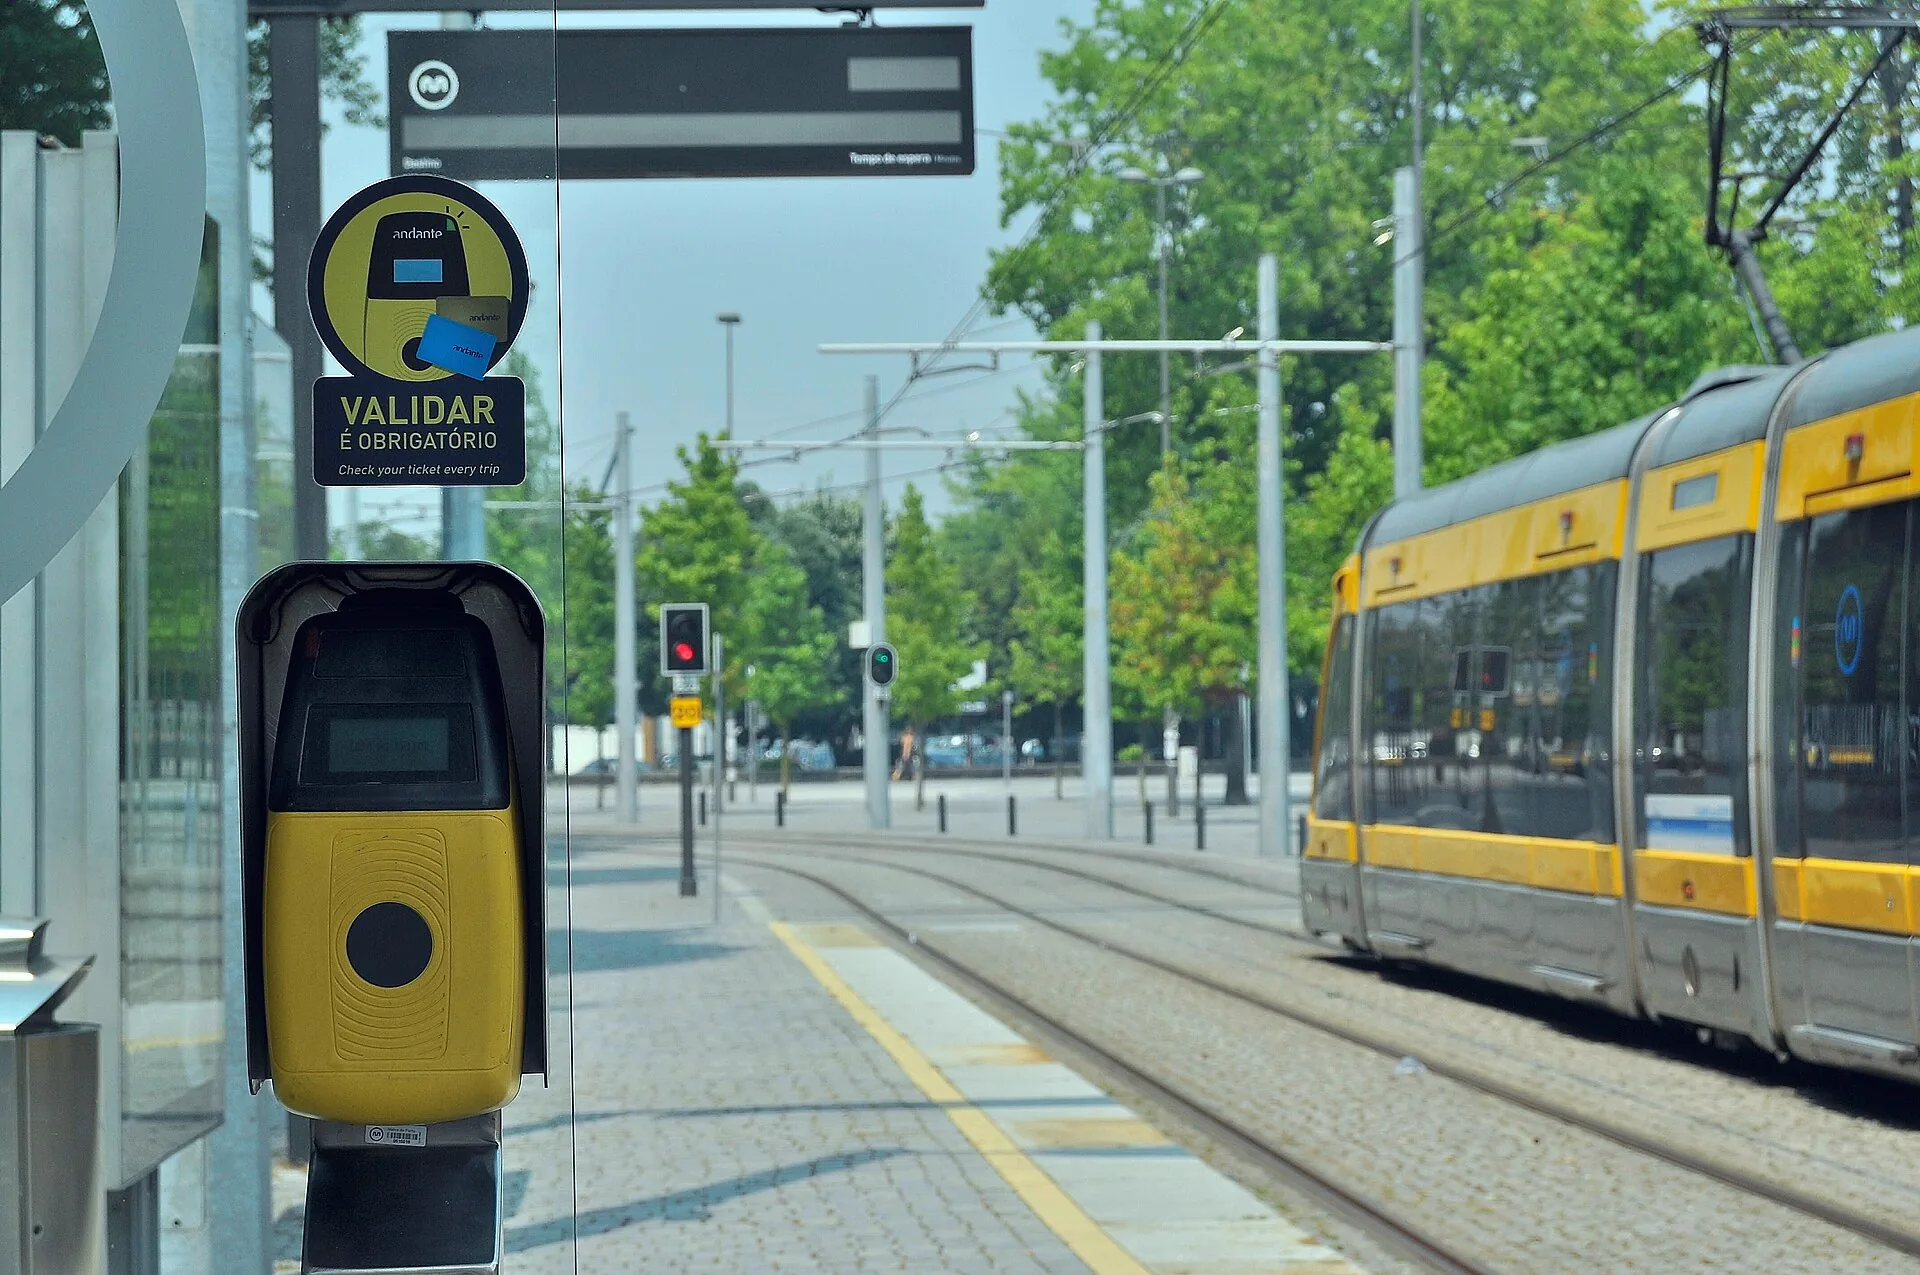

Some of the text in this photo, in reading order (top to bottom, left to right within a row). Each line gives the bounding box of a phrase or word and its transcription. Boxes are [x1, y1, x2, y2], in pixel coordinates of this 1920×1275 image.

[392, 227, 443, 239] andante
[469, 313, 502, 322] andante
[452, 344, 484, 359] andante
[340, 395, 495, 425] VALIDAR
[340, 426, 497, 450] É OBRIGATÓRIO
[338, 463, 500, 478] Check your ticket every trip
